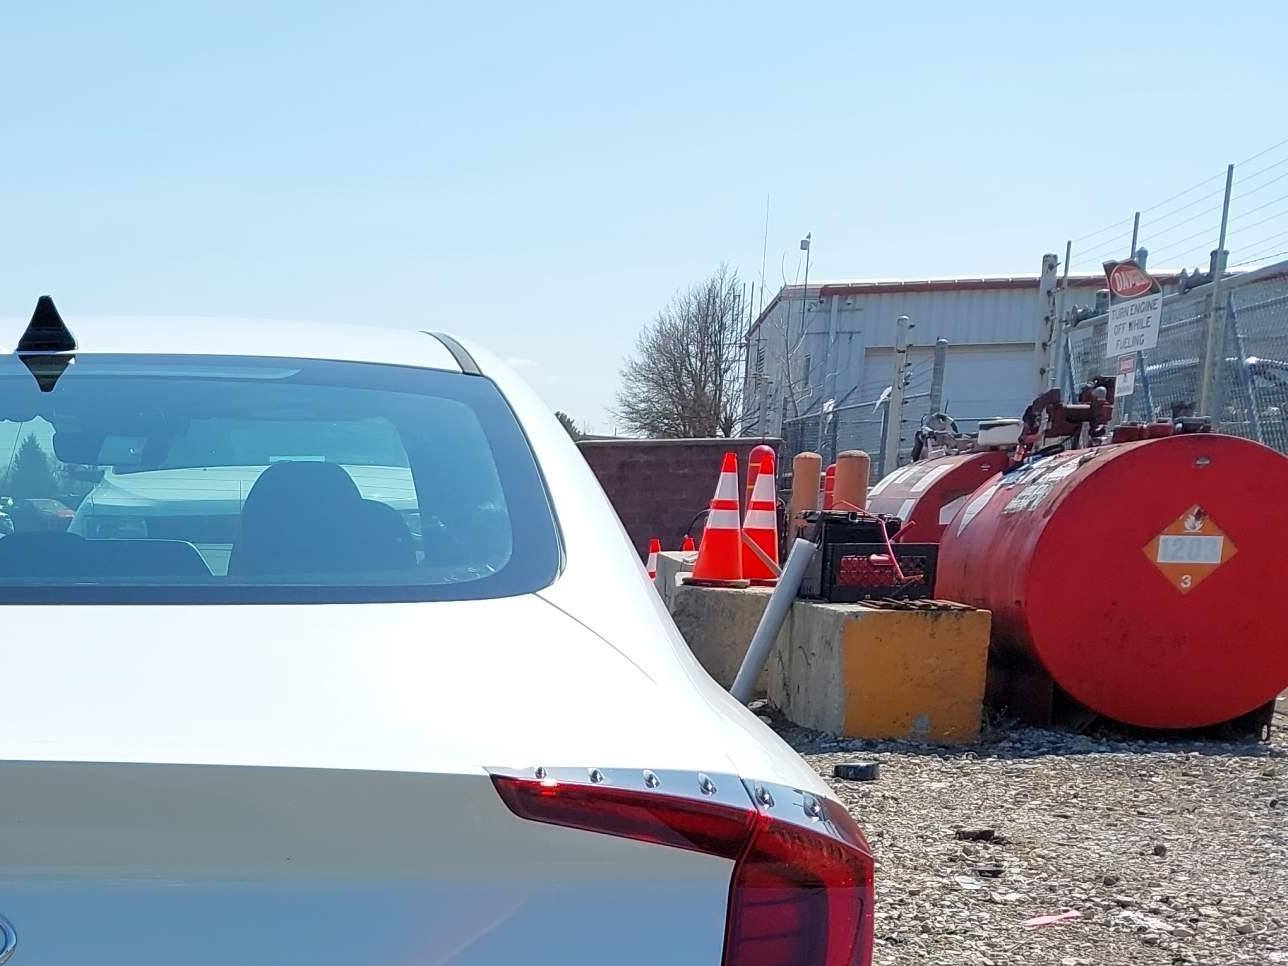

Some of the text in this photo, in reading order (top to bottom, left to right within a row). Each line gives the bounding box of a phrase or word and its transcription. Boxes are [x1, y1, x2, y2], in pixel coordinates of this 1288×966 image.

[1129, 298, 1159, 316] ENGINE
[1114, 316, 1152, 336] OFF WHILE
[1115, 334, 1145, 350] FUELING
[1180, 574, 1192, 588] 3
